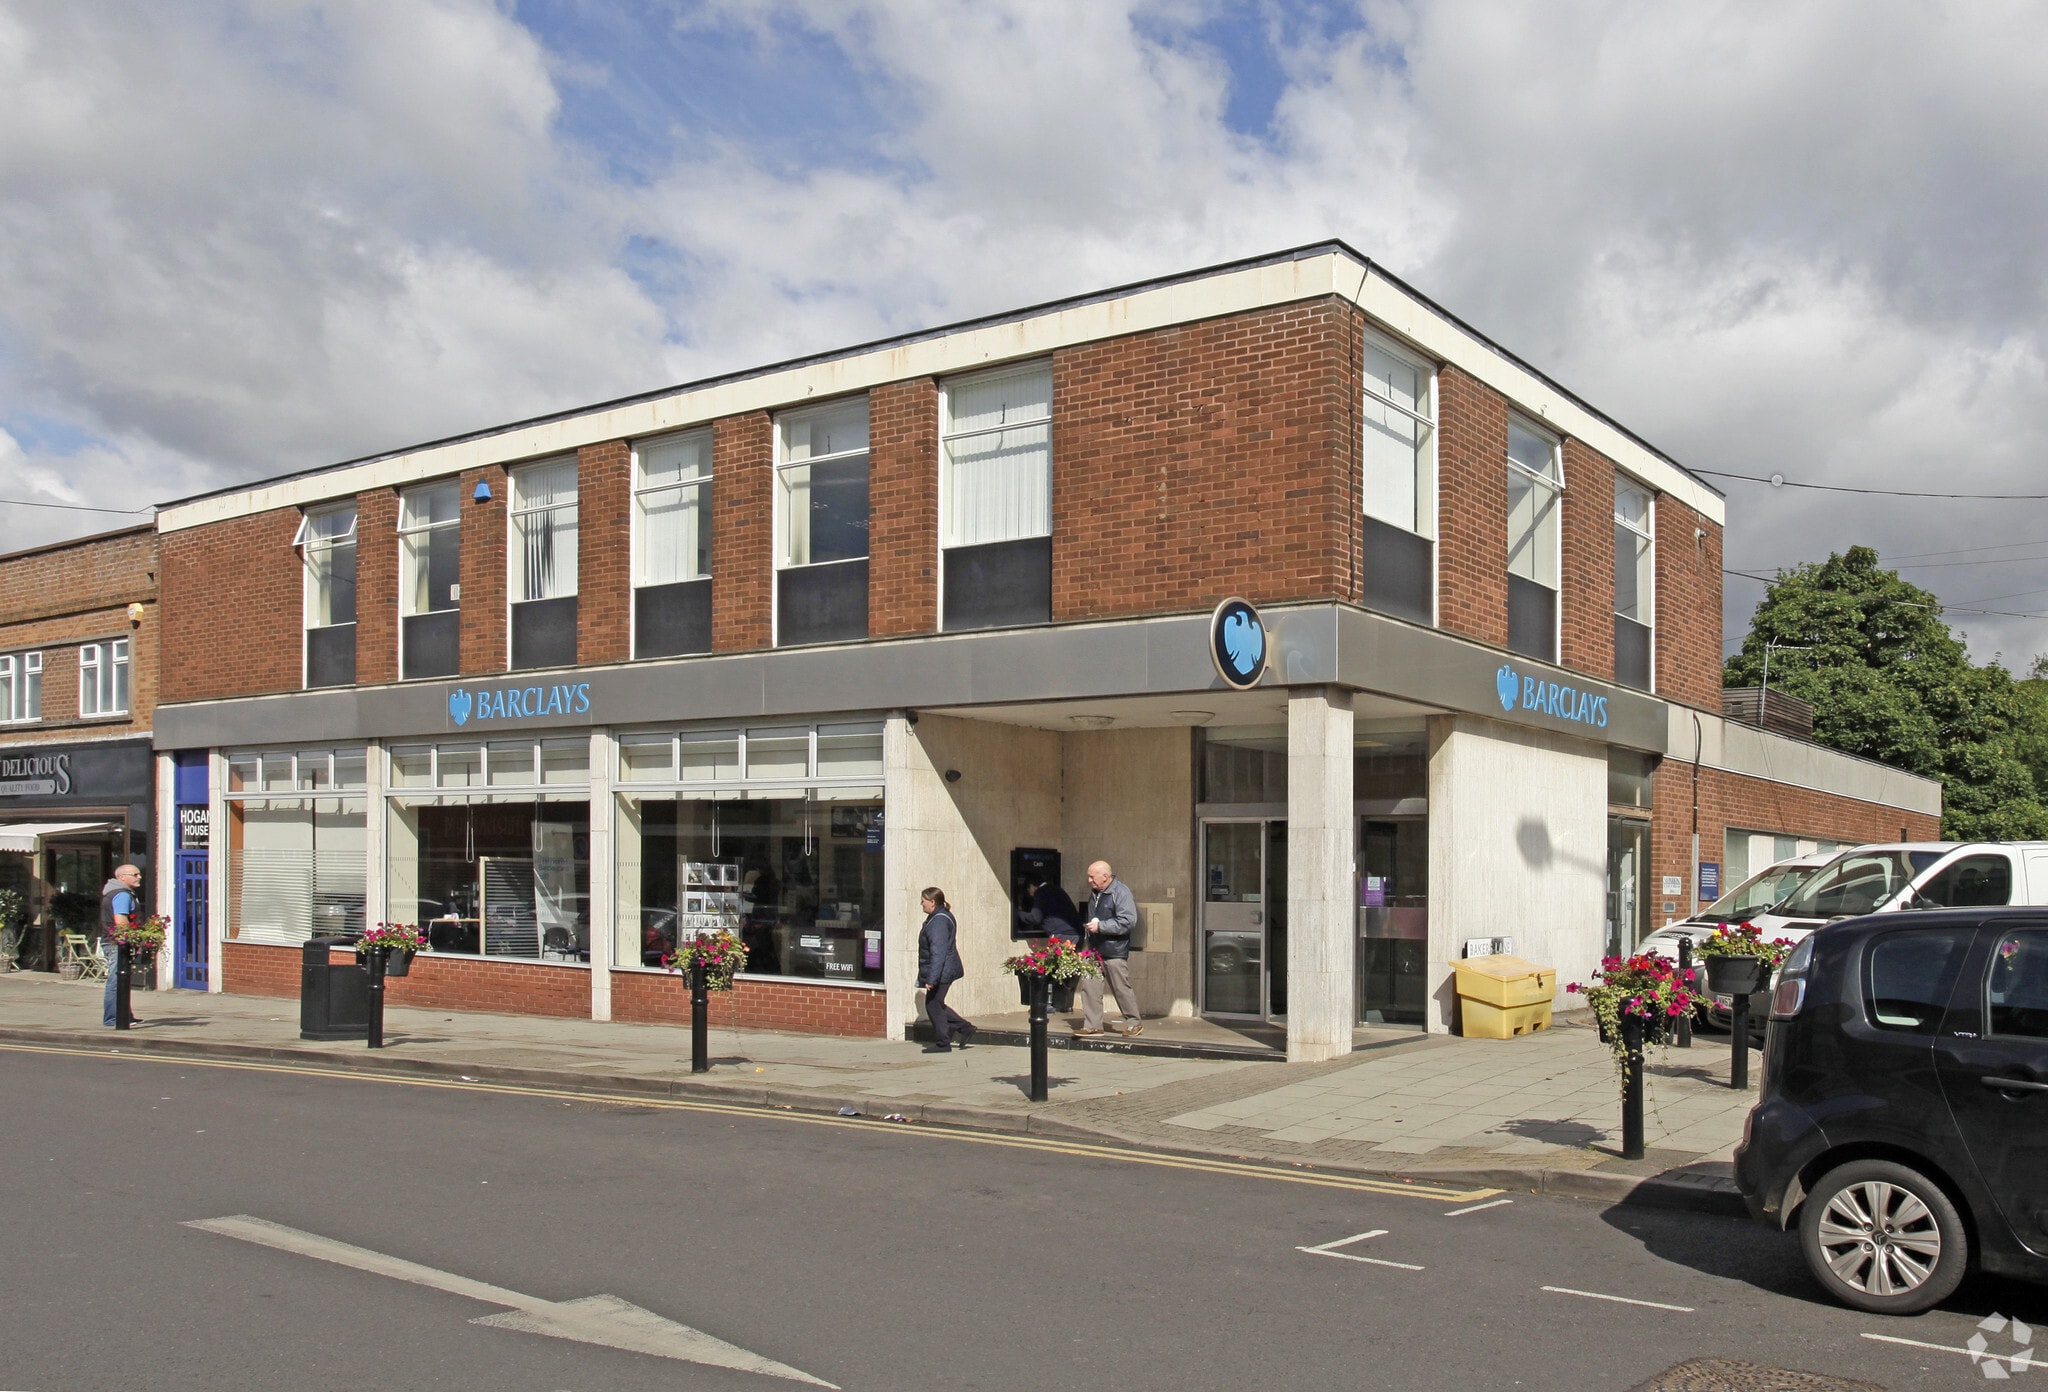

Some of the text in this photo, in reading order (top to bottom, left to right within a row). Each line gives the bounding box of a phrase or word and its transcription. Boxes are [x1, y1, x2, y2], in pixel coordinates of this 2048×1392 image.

[477, 683, 590, 719] BARCLAYS
[1522, 676, 1608, 728] BARCLAYS
[2, 754, 71, 795] DELICIOUS
[1, 783, 40, 794] QUALITY FOOD
[184, 825, 209, 836] HOUSE
[826, 962, 840, 971] FREE
